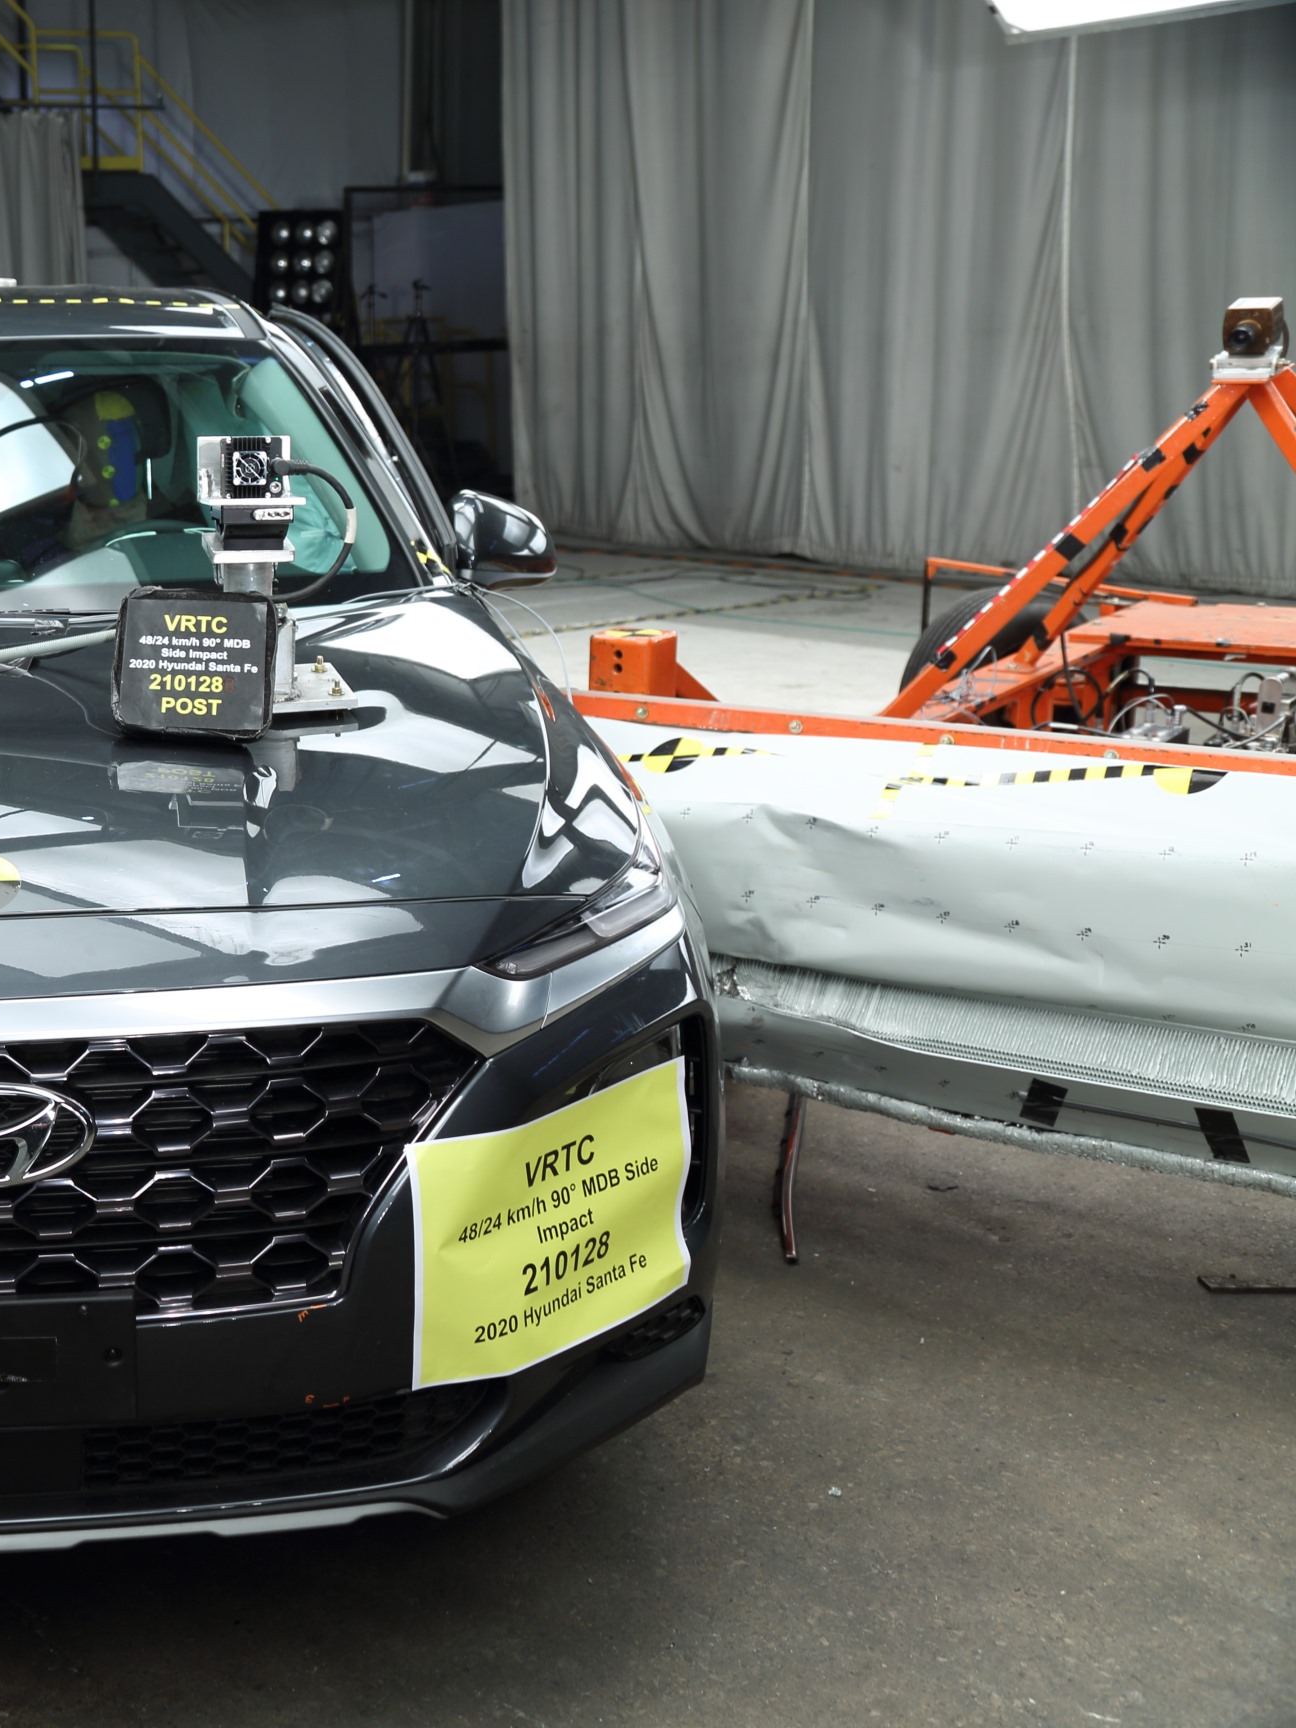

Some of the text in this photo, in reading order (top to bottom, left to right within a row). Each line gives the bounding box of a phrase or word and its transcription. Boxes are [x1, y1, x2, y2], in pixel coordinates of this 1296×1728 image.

[164, 614, 228, 634] VRTC
[139, 635, 170, 646] 48/24
[171, 636, 200, 647] km/h
[223, 638, 251, 649] MDB
[161, 647, 227, 661] Side Impact
[129, 659, 258, 674] 2020 Hyundai Santa Fe
[148, 673, 224, 693] 210128
[161, 697, 222, 716] POST
[524, 1134, 595, 1188] VRTC
[458, 1156, 659, 1243] 48/24 km/h 90° MDB Side
[536, 1208, 594, 1247] Impact
[521, 1230, 610, 1296] 210128
[474, 1253, 648, 1344] 2020 Hyundai Santa Fe
